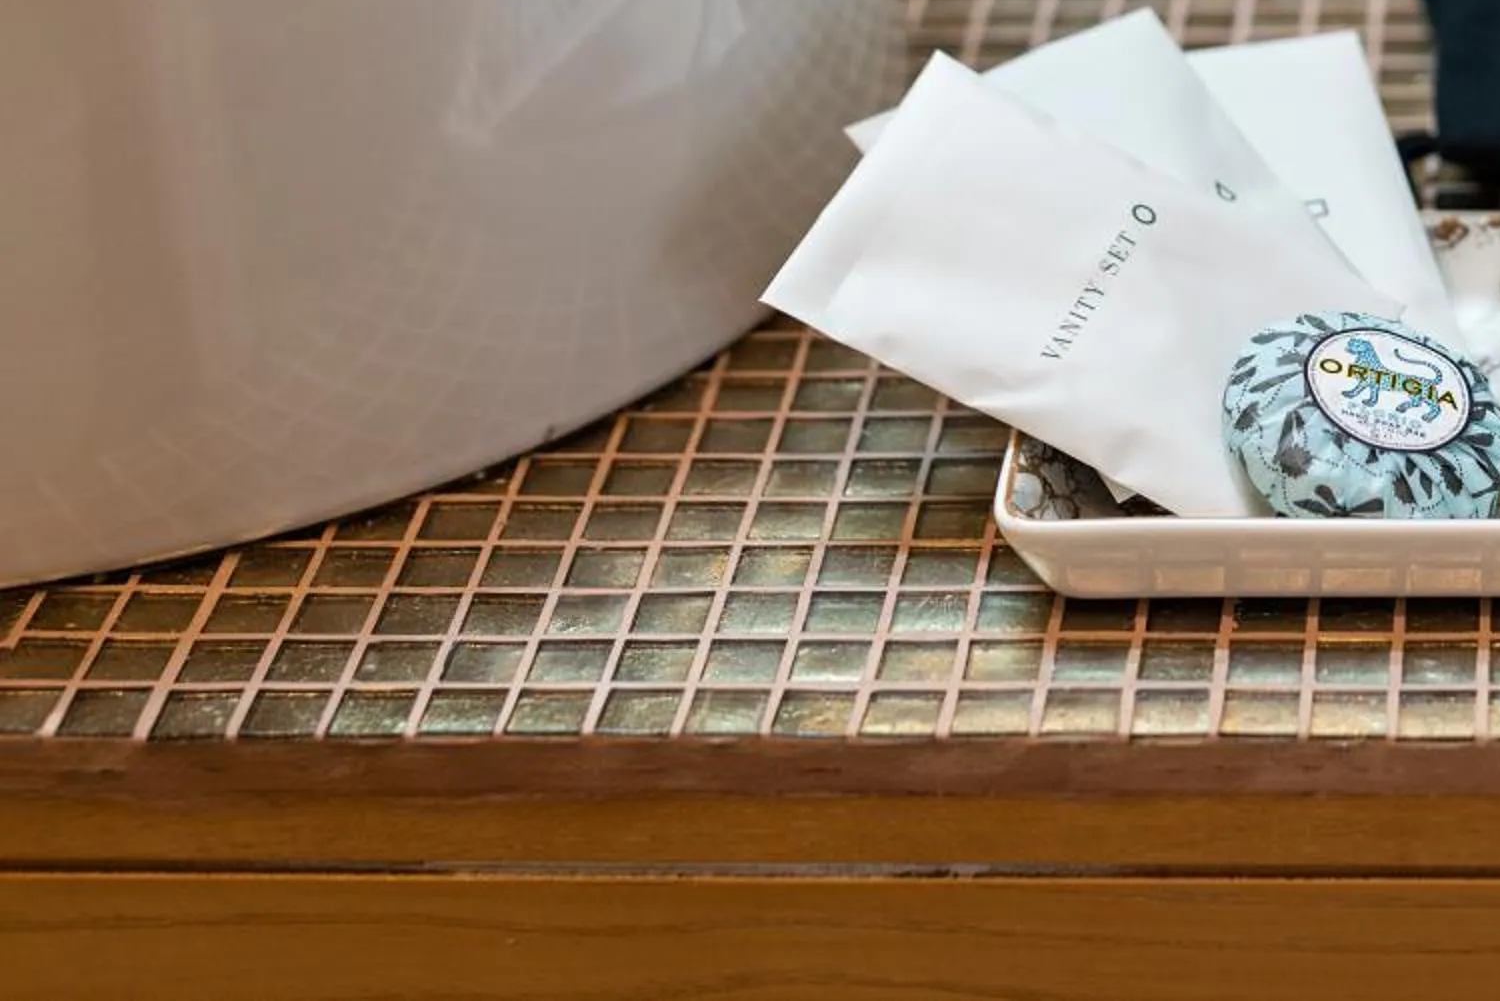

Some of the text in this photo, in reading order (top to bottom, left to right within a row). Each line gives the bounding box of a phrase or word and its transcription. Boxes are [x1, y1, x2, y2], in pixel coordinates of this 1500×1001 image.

[1041, 278, 1104, 360] VANITY
[1099, 230, 1136, 276] SET
[1319, 358, 1459, 410] ORTIGIA
